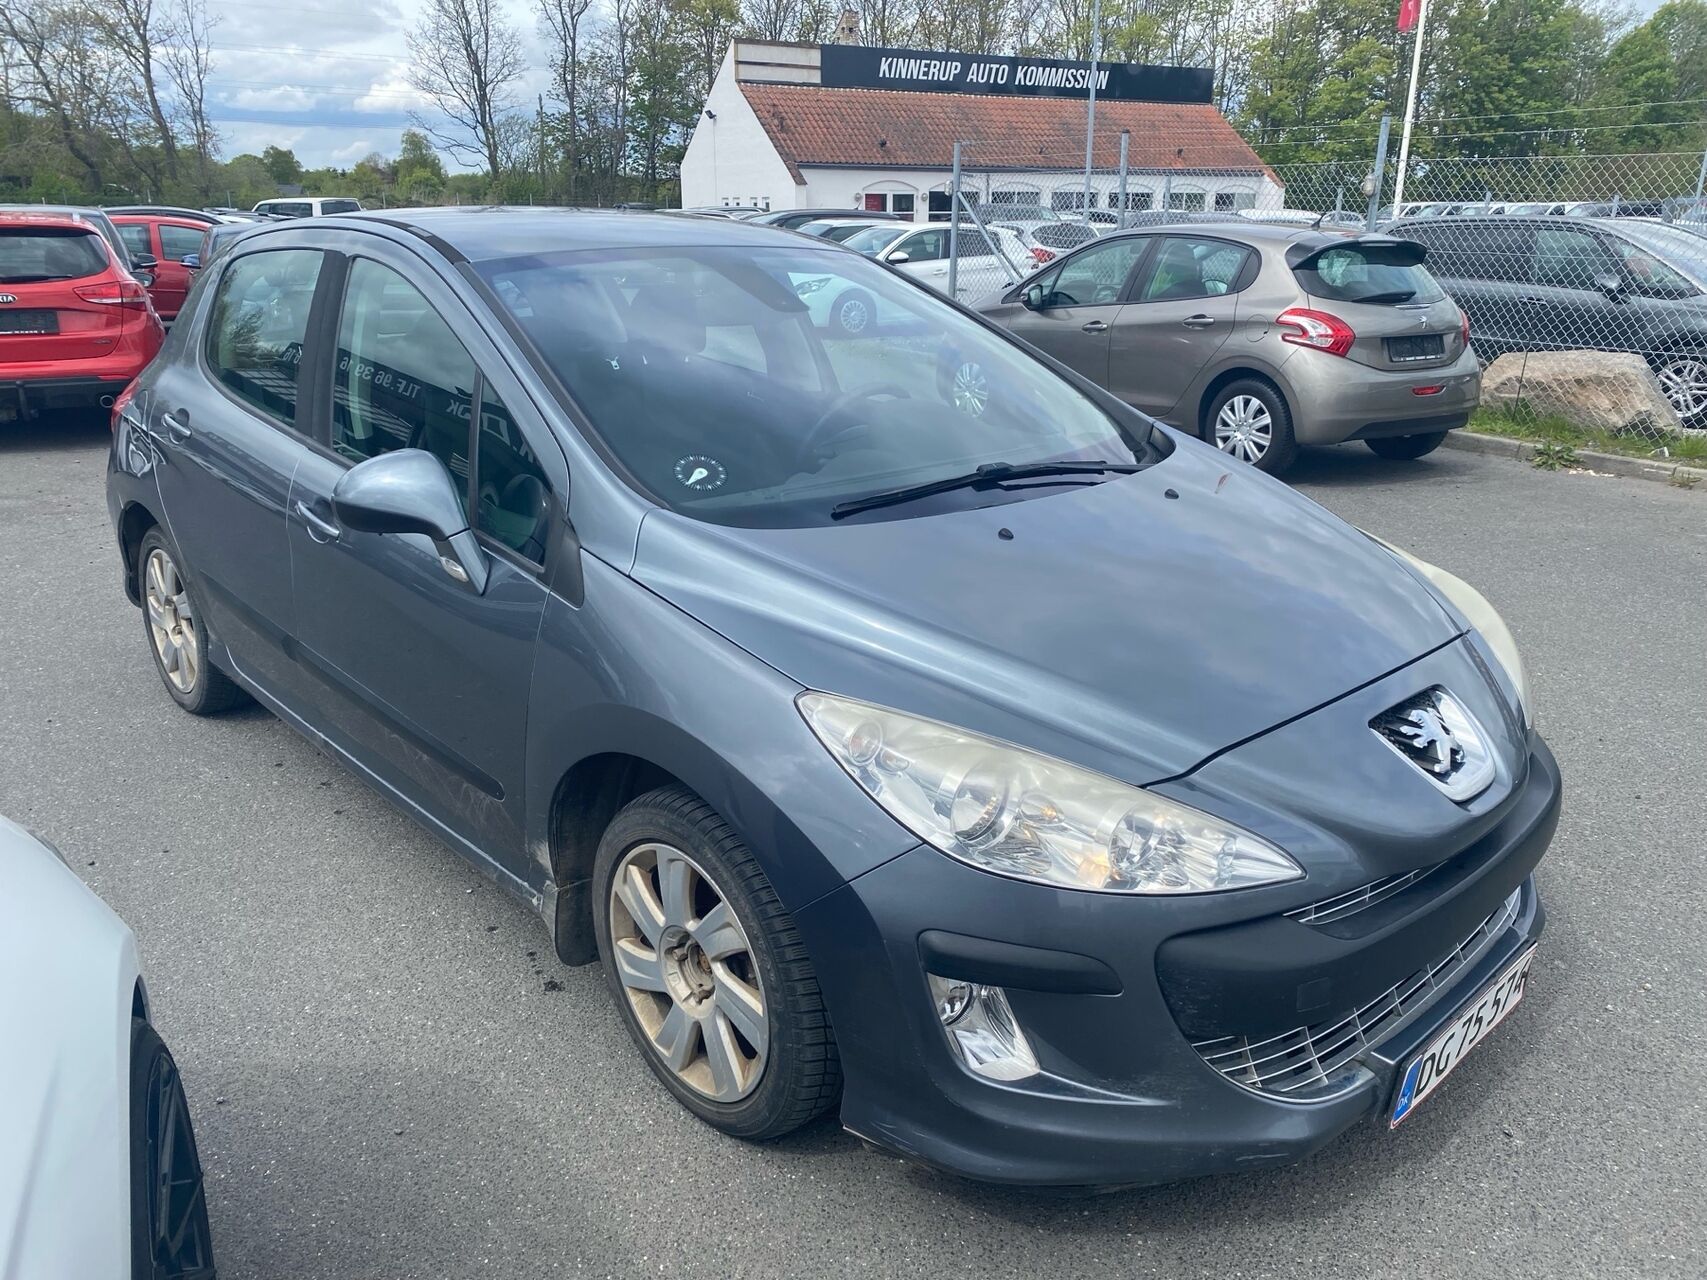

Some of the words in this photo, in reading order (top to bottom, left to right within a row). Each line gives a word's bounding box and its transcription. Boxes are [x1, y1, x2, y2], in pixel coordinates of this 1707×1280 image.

[879, 57, 960, 83] KINNERUP
[967, 62, 1008, 85] AUTO
[1414, 1032, 1455, 1099] DG
[1455, 1000, 1488, 1059] 75
[1397, 1092, 1411, 1111] DK
